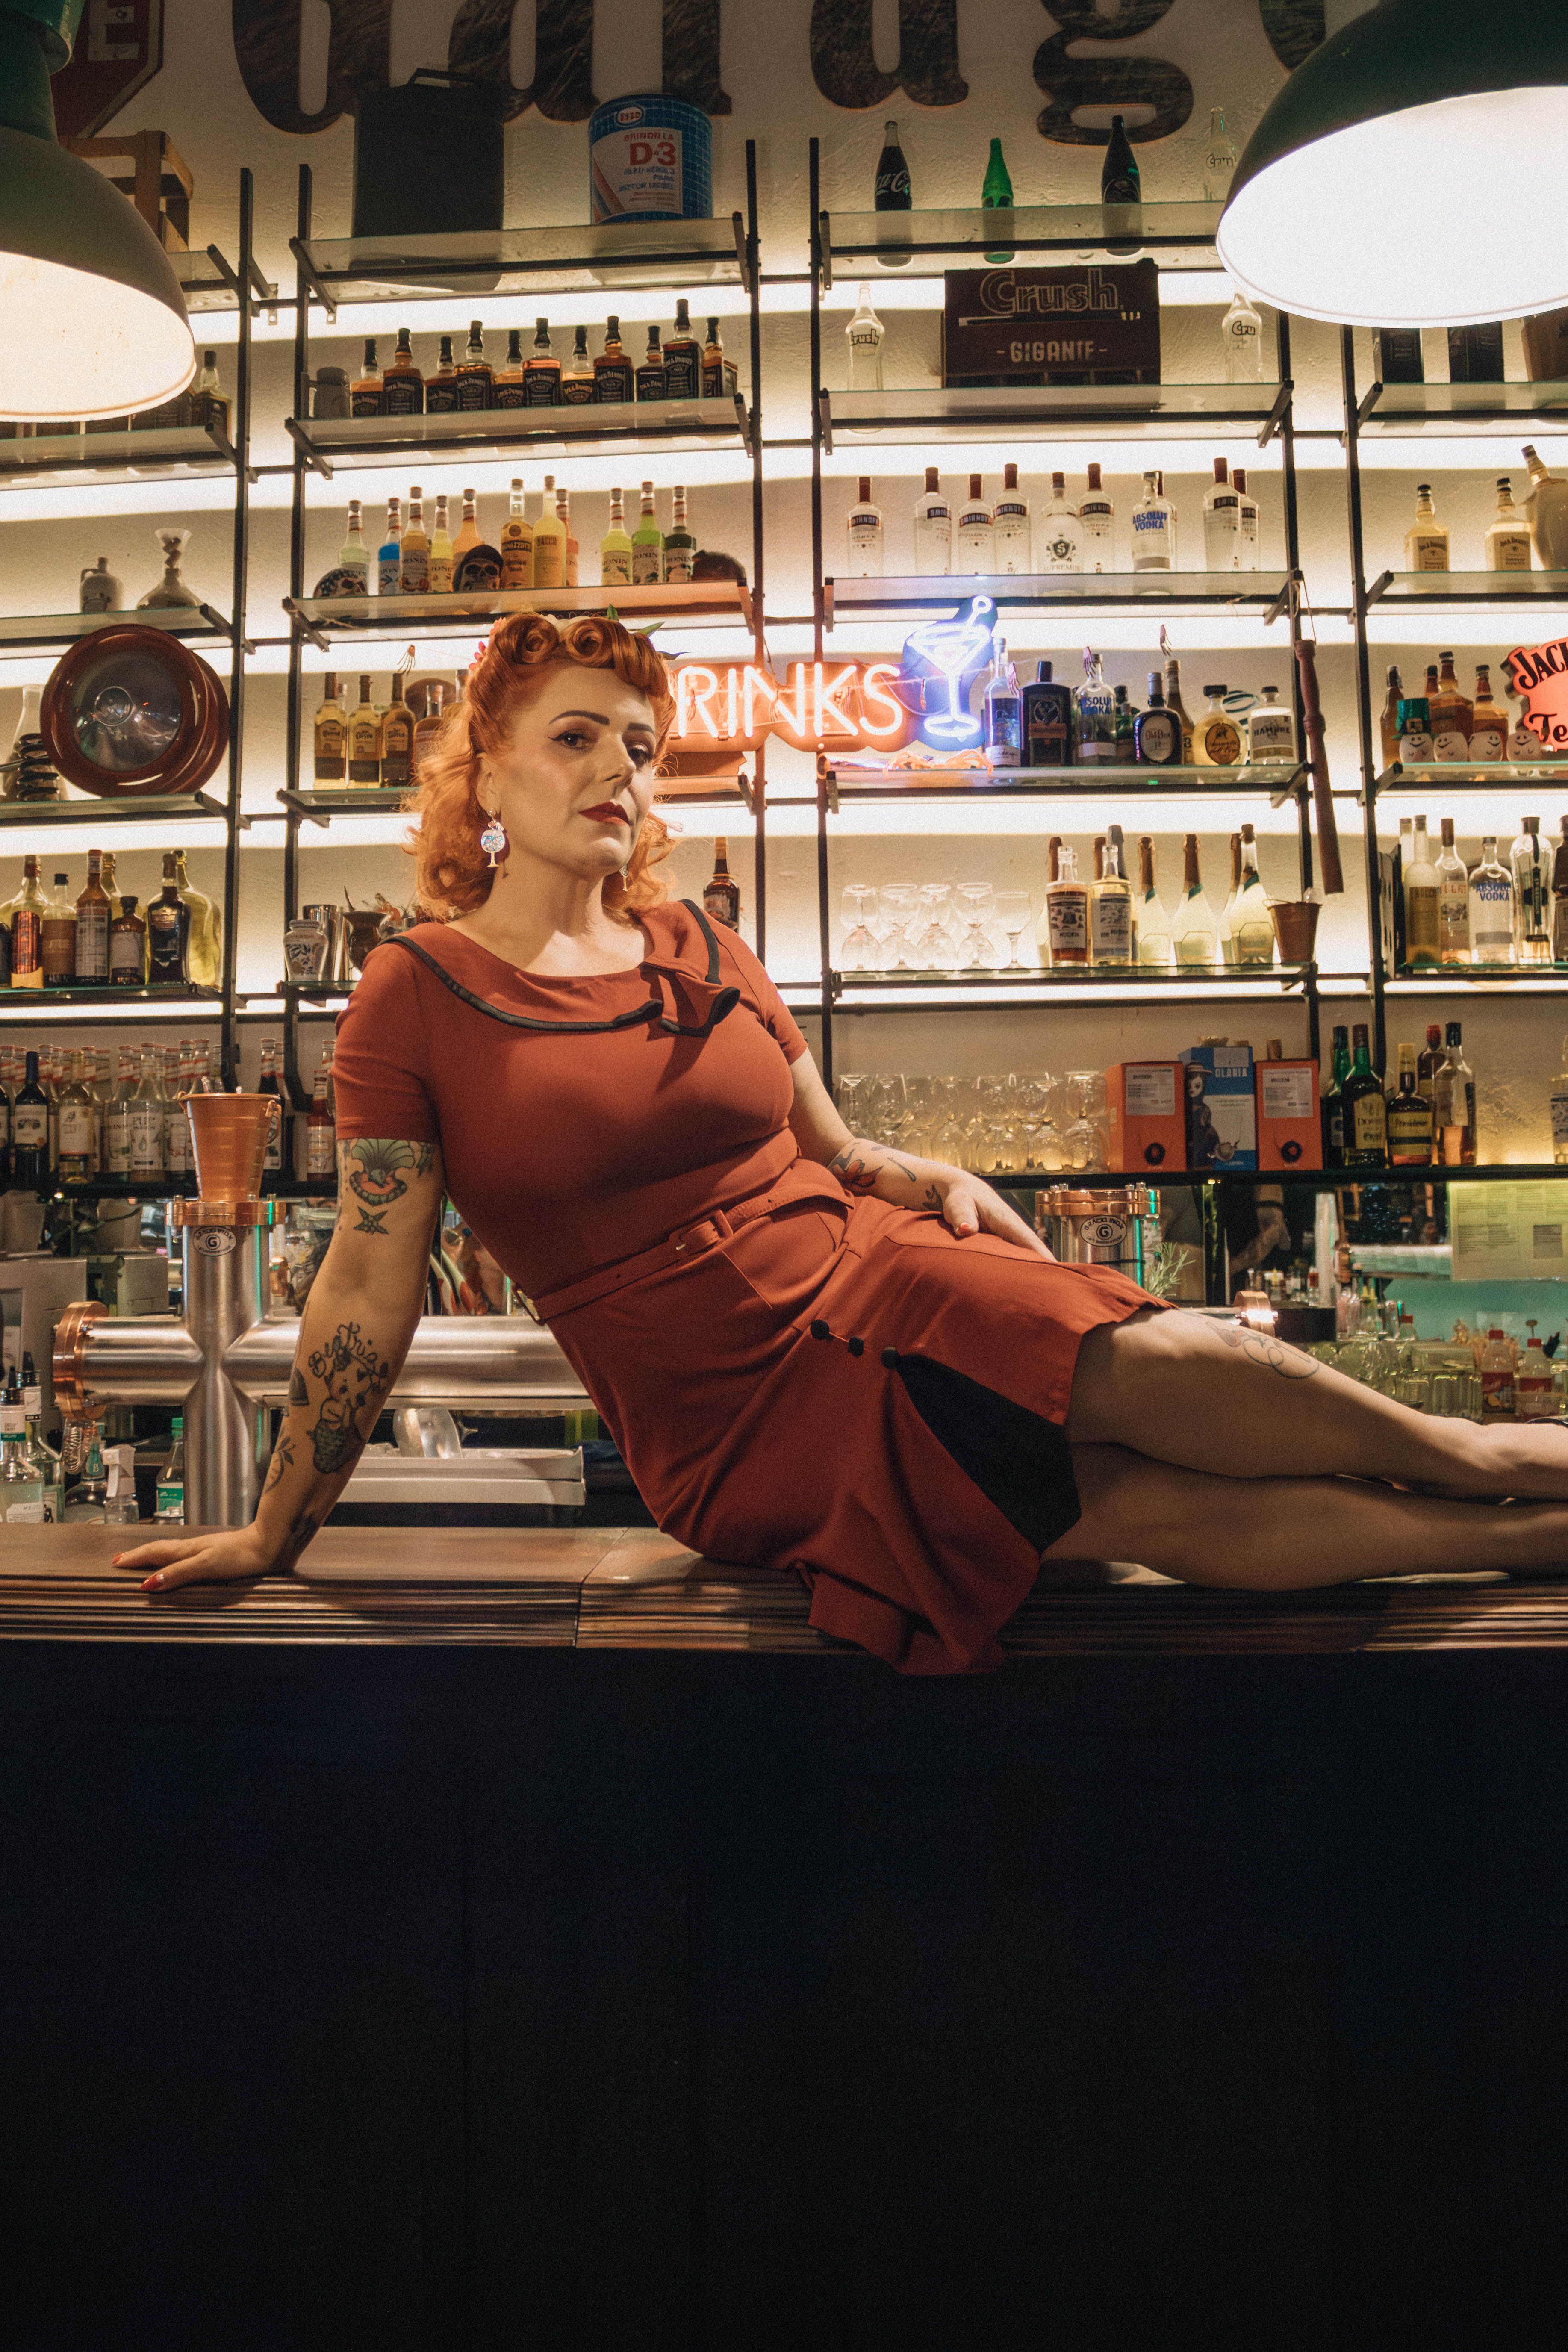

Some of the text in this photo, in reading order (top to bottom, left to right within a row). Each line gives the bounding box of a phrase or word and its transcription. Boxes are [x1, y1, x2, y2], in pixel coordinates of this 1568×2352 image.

[630, 141, 676, 166] D-3
[979, 268, 1119, 315] Crush
[1135, 519, 1164, 532] VODKA
[677, 662, 903, 738] RINKS
[1480, 892, 1509, 902] VODKA
